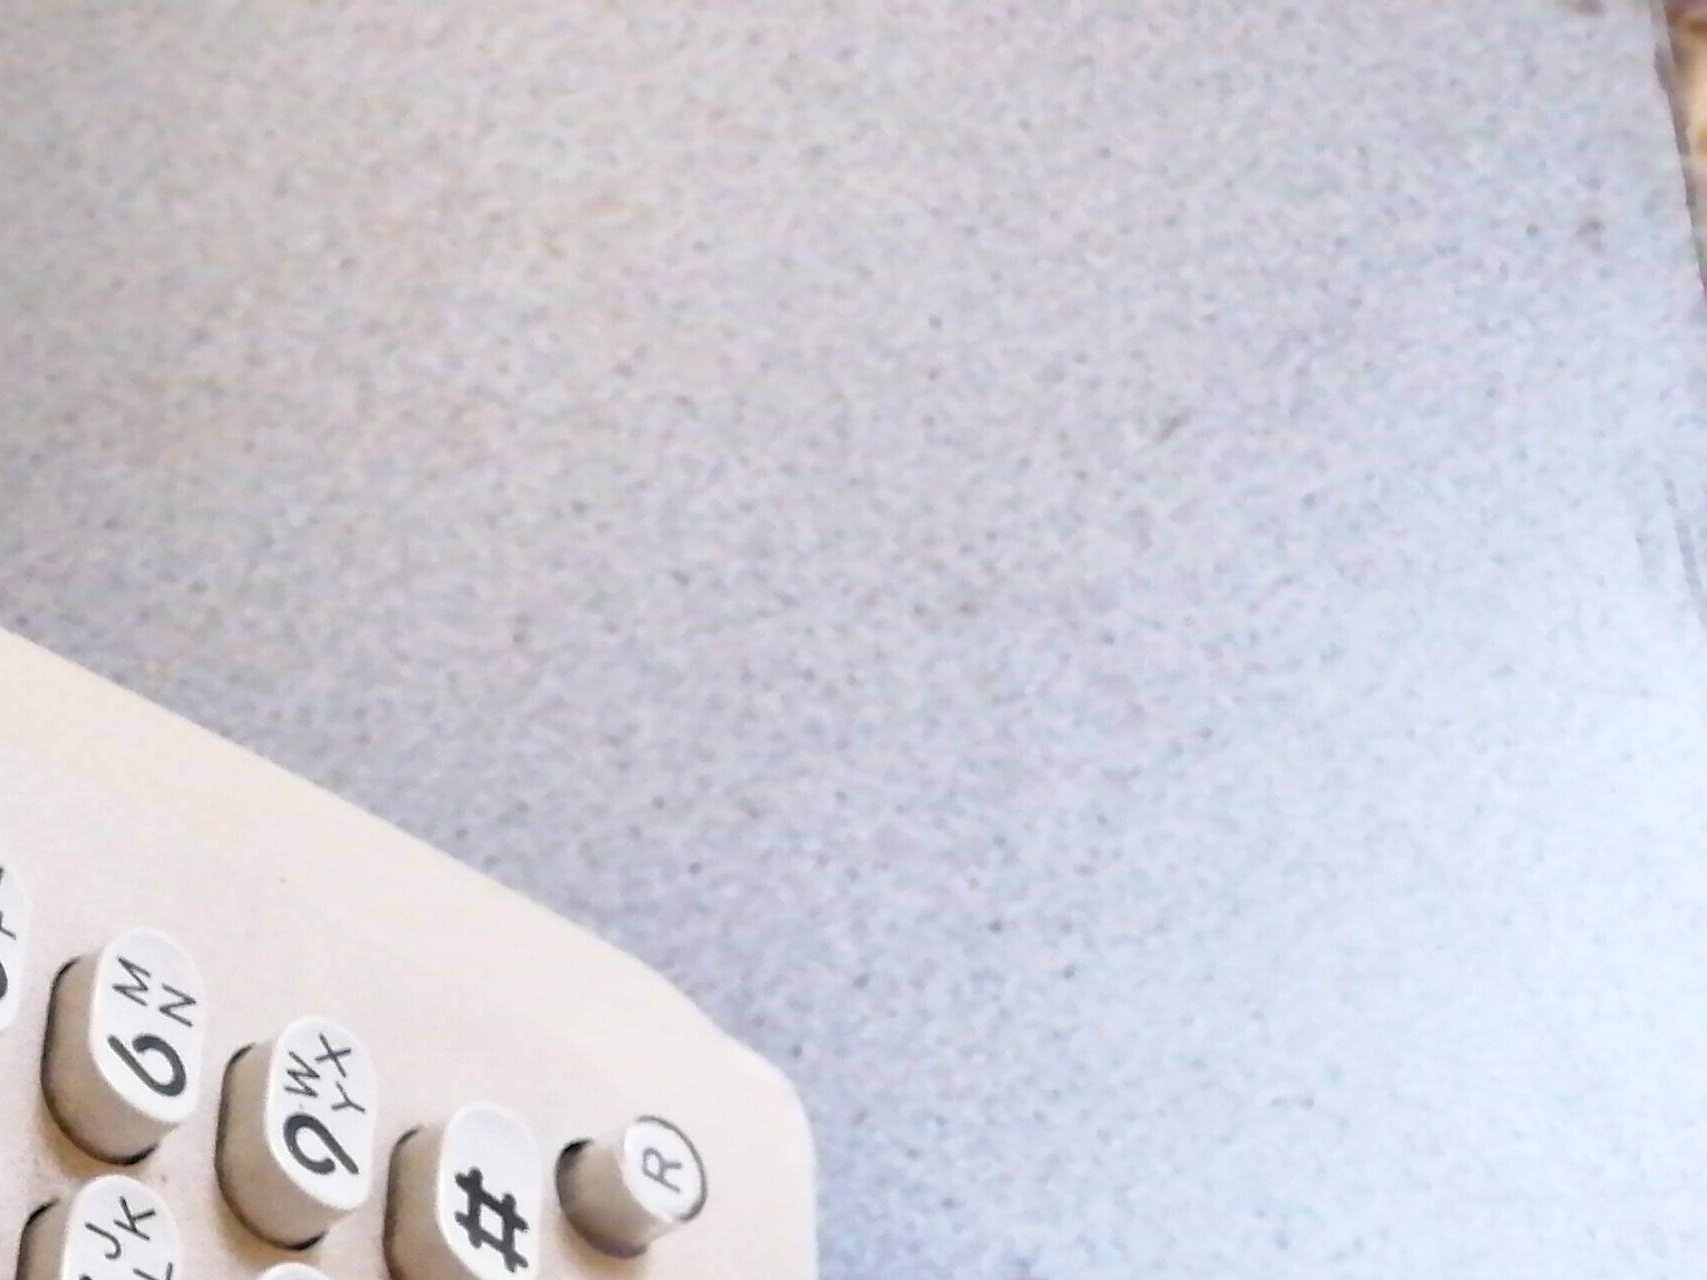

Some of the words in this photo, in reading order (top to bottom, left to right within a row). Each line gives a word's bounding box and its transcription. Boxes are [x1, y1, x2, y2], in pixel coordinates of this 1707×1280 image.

[107, 1033, 187, 1097] 6
[283, 1113, 359, 1176] 9
[641, 1146, 683, 1194] R
